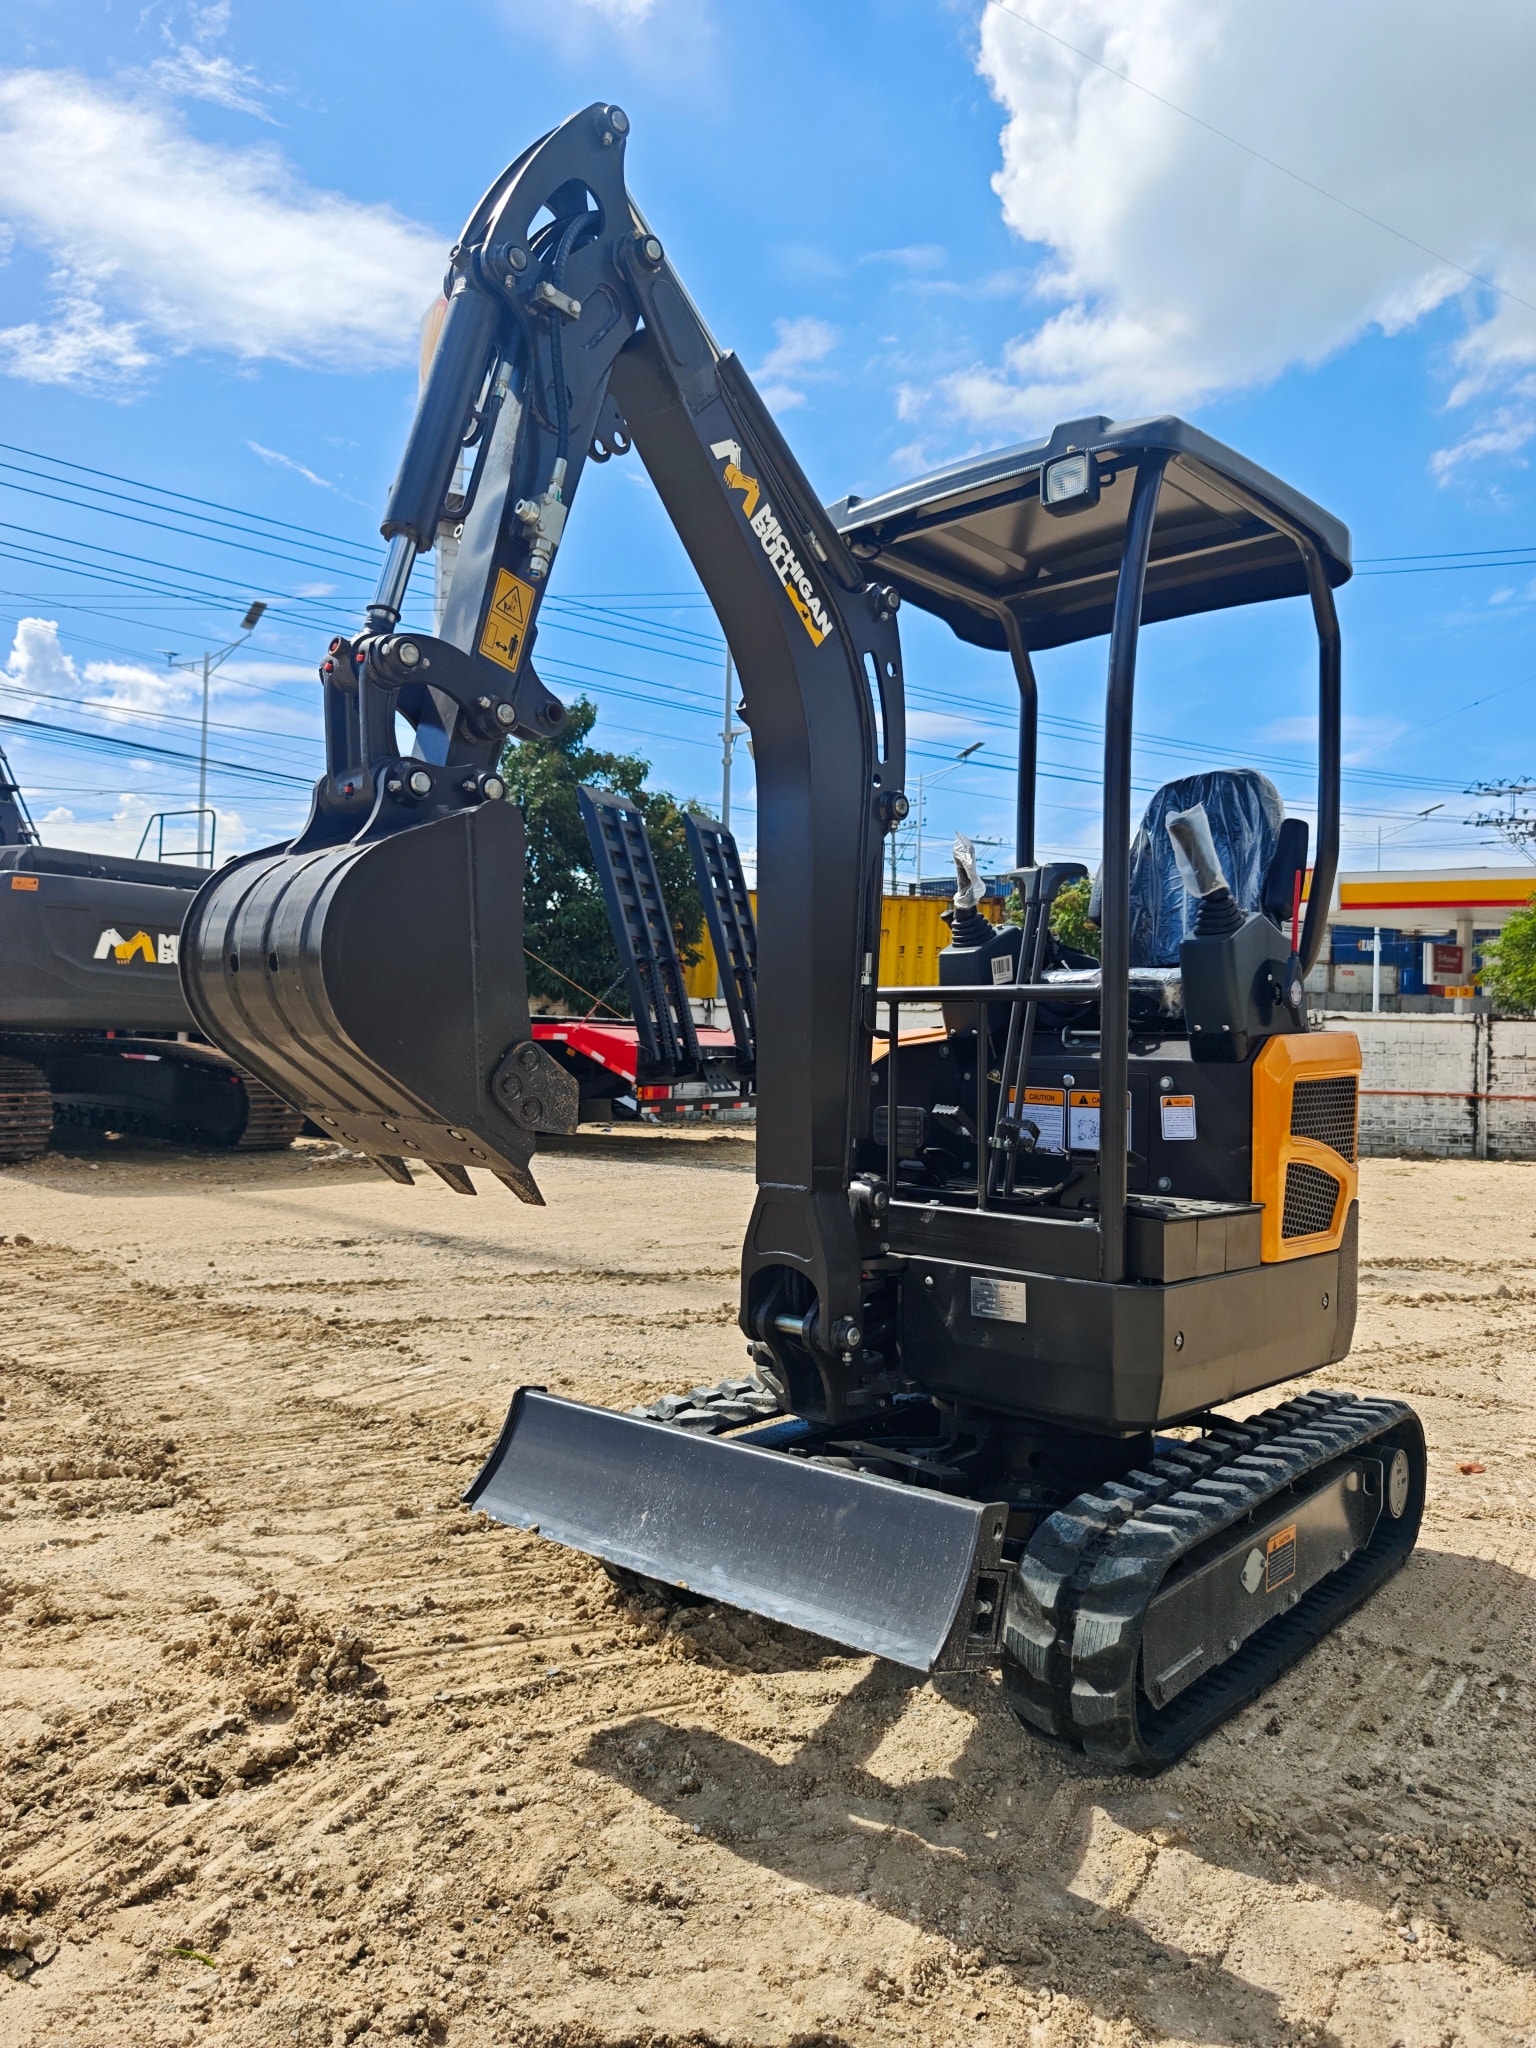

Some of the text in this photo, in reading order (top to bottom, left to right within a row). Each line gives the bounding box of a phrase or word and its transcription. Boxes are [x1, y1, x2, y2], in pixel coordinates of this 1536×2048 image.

[750, 513, 792, 588] BULL
[757, 503, 834, 638] MICHIGAN
[1029, 1093, 1055, 1102] CAUTION
